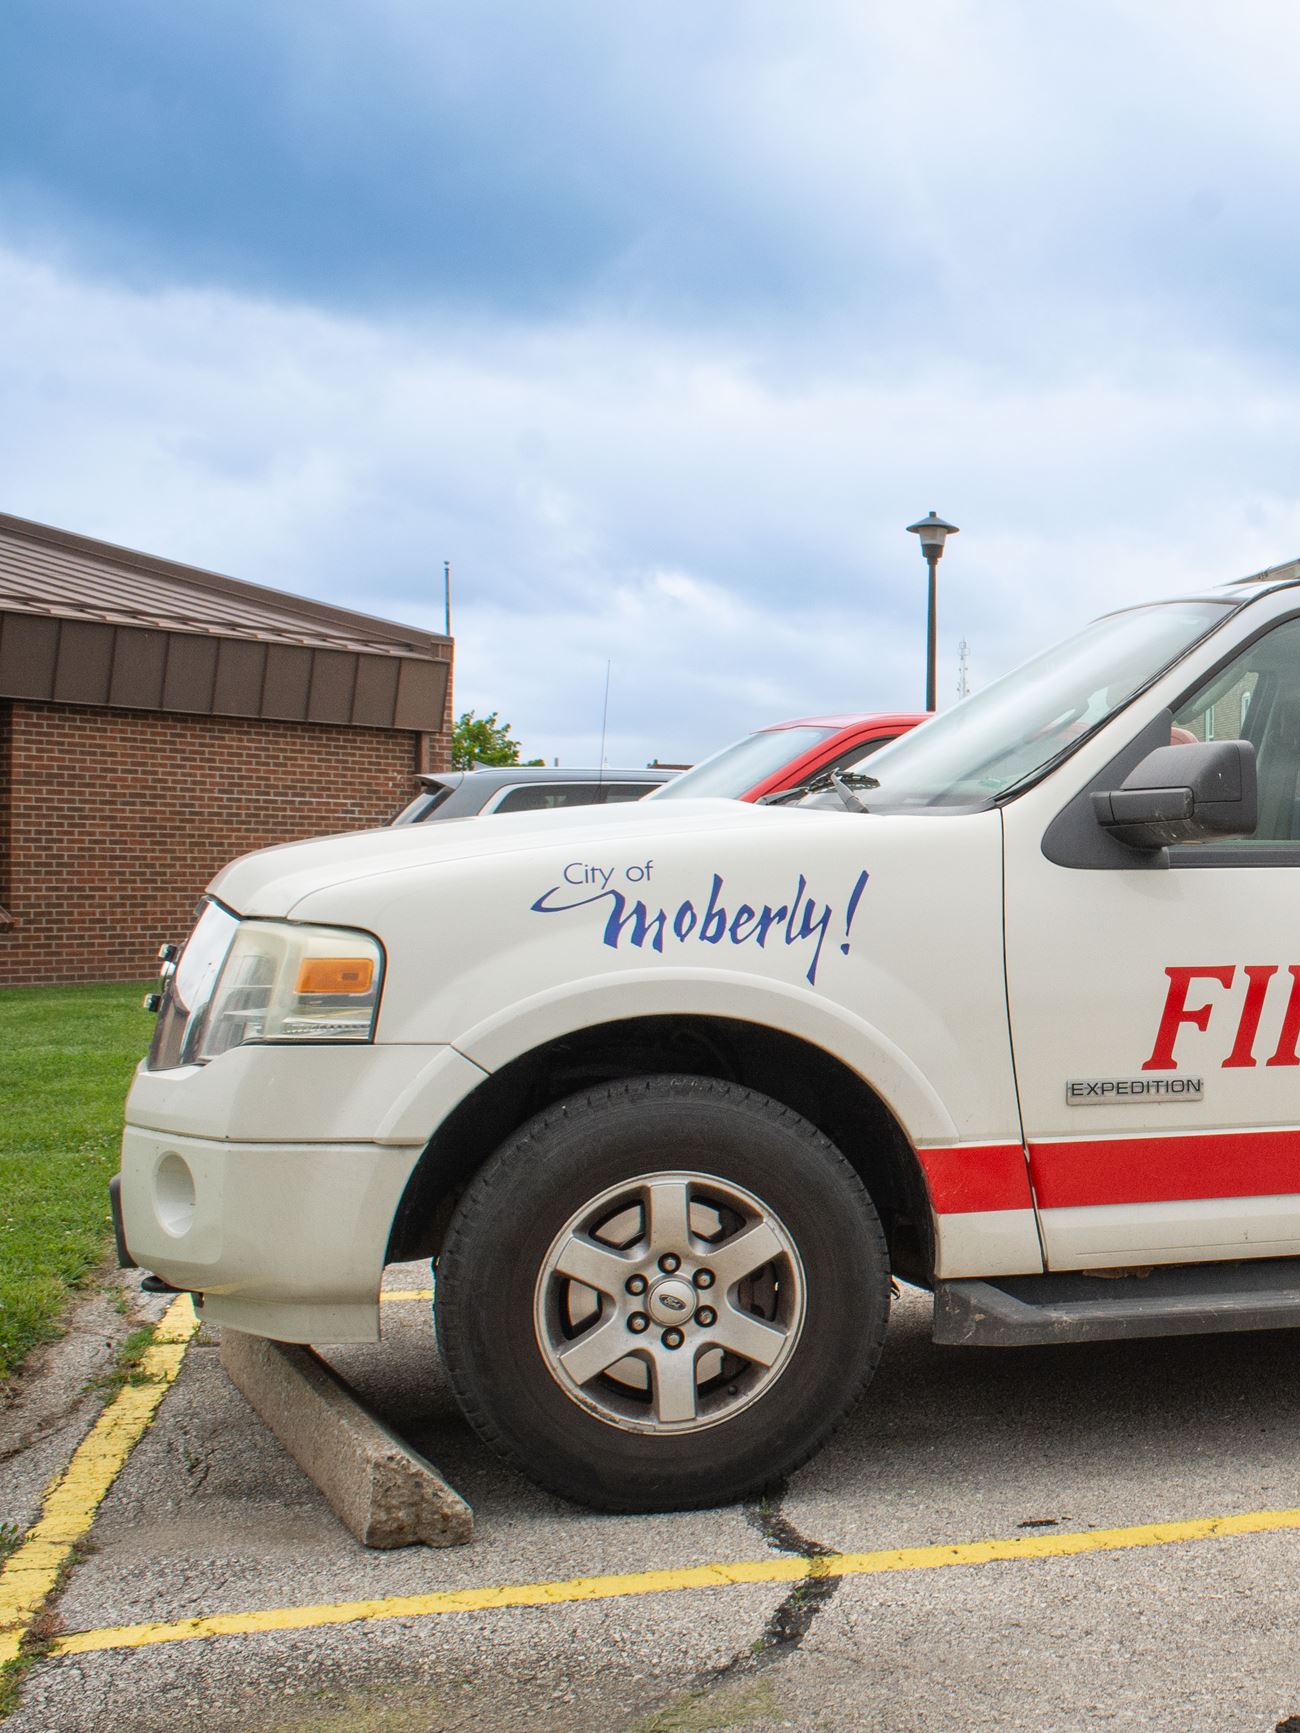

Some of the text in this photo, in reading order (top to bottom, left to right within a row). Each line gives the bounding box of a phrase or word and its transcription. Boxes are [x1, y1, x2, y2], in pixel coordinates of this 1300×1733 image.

[563, 860, 654, 890] City of
[1071, 1079, 1201, 1096] EXPEDITION
